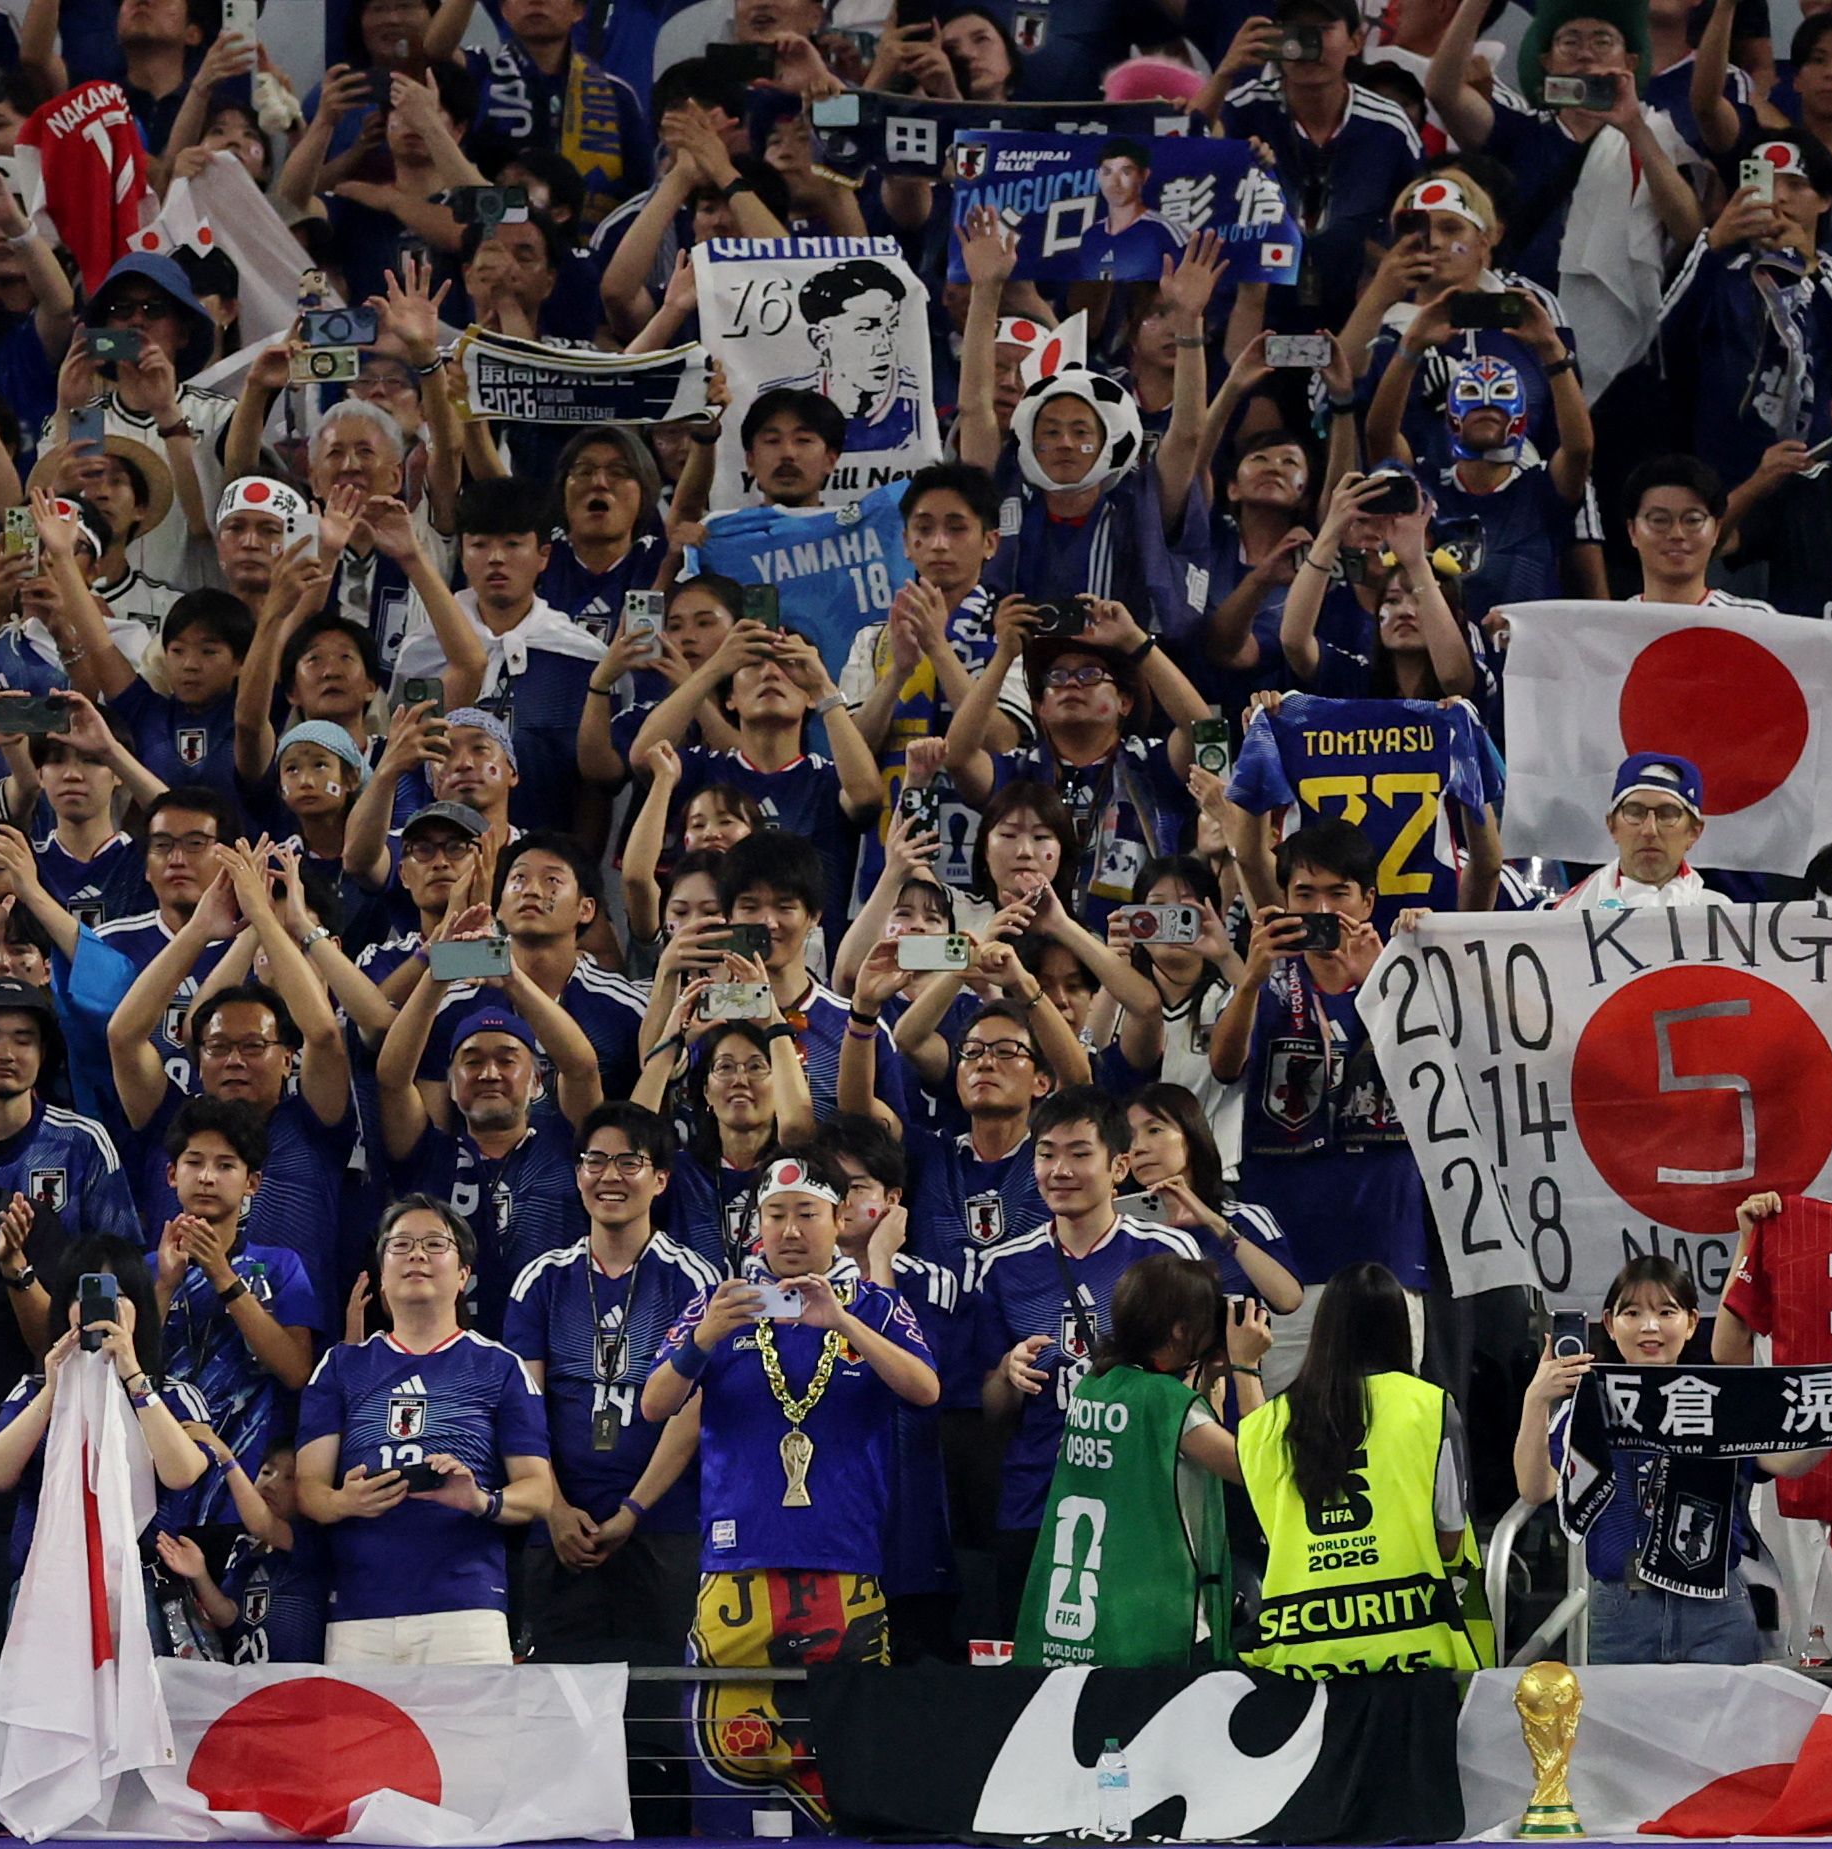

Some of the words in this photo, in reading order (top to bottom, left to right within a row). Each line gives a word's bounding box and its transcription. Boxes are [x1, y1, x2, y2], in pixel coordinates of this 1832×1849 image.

[487, 52, 528, 139] JAP
[994, 160, 1036, 172] BLUE
[995, 150, 1071, 163] SAMURAI
[723, 280, 794, 338] 16
[480, 386, 536, 418] 2026
[750, 526, 883, 583] YAMAHA
[849, 562, 892, 613] 18
[1303, 726, 1434, 757] TOMIYASU
[1652, 999, 1757, 1184] 5
[1409, 1060, 1567, 1170] 214
[1622, 1226, 1733, 1293] NAG
[593, 1383, 635, 1428] 14
[1067, 1396, 1129, 1434] PHOTO
[1067, 1433, 1114, 1471] 0985
[1669, 1442, 1704, 1455] TEAM
[1719, 1439, 1775, 1453] SAMURAI
[1776, 1439, 1808, 1451] BLUE
[1320, 1510, 1355, 1527] FIFA
[1575, 1472, 1617, 1528] SAMURAI
[1307, 1540, 1348, 1557] WORLD
[1350, 1536, 1377, 1552] CUP
[1307, 1550, 1380, 1575] 2026
[1054, 1609, 1082, 1628] FIFA
[1259, 1584, 1436, 1643] SECURITY
[233, 1628, 270, 1664] 20
[1073, 1644, 1096, 1661] CUP
